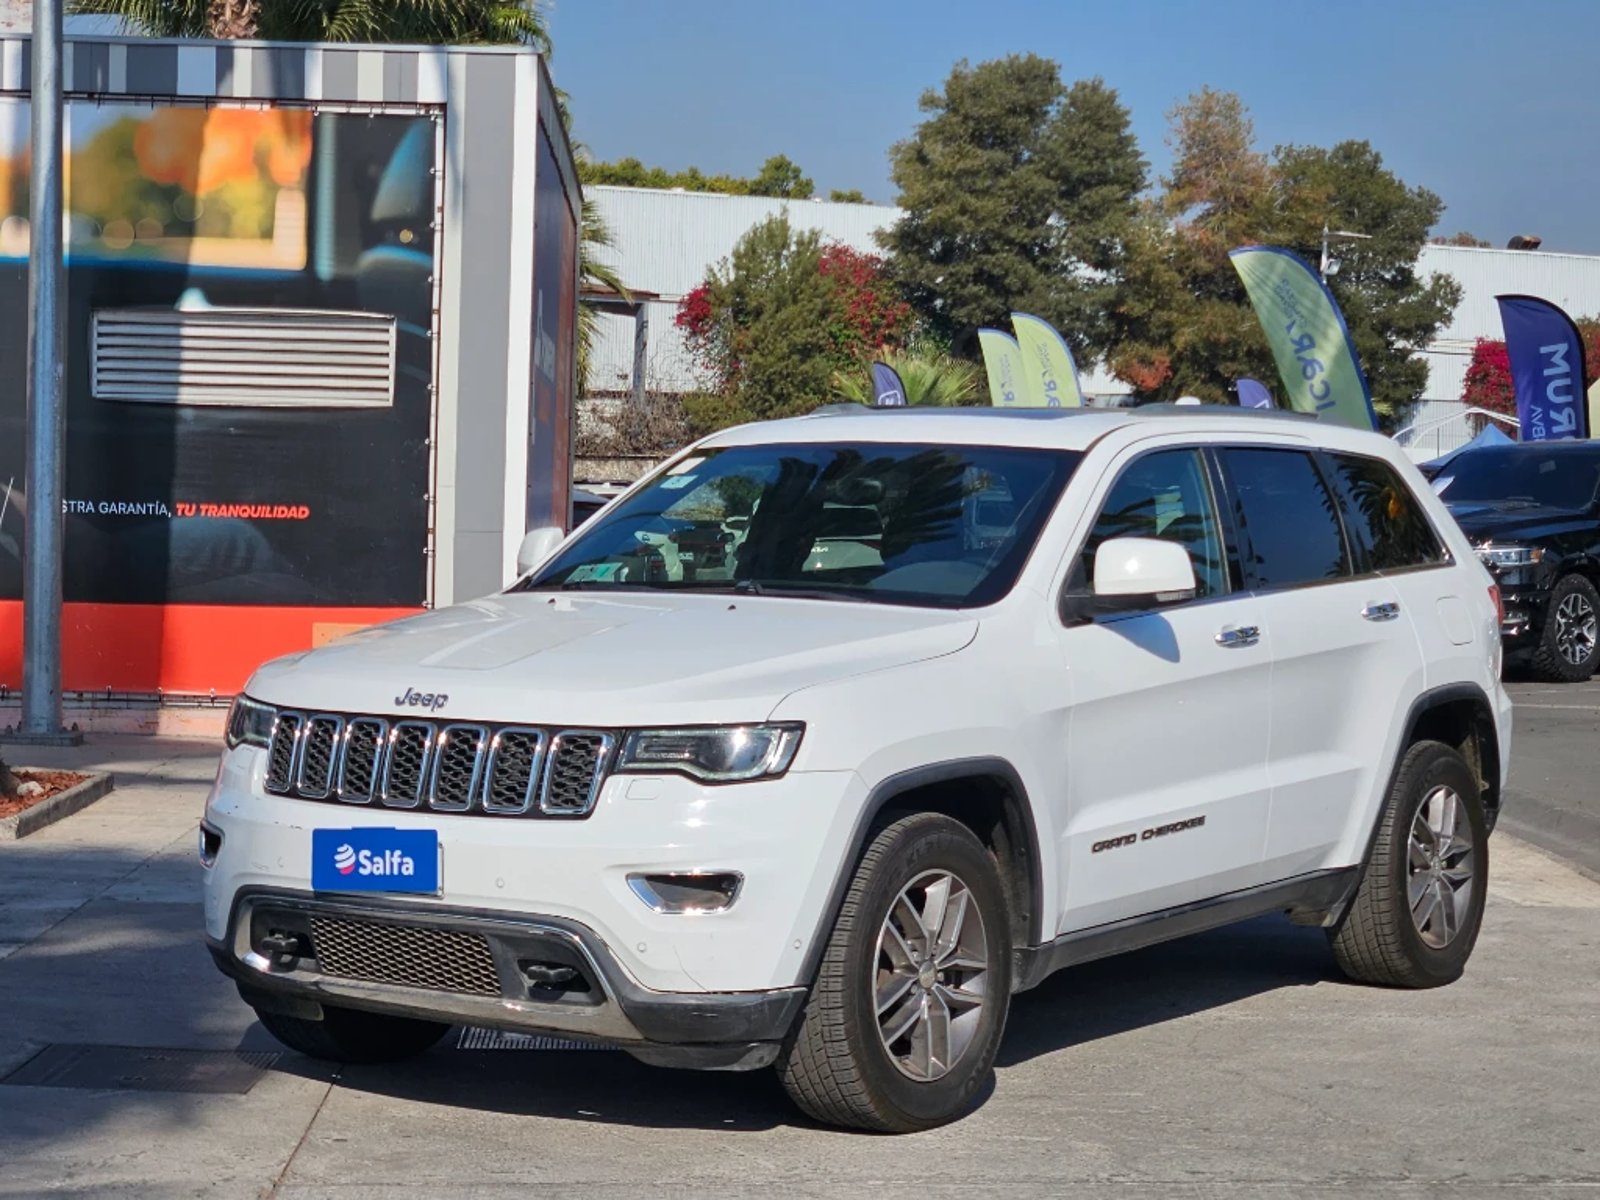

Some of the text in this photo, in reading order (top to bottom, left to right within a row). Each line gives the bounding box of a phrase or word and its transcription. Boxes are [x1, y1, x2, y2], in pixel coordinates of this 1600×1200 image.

[62, 499, 310, 519] STRA GARANTÍA, TU TRANQUILIDAD
[394, 687, 449, 712] Jeep
[1092, 815, 1206, 854] GRAND CHEROKEE
[358, 849, 415, 876] Salfa
